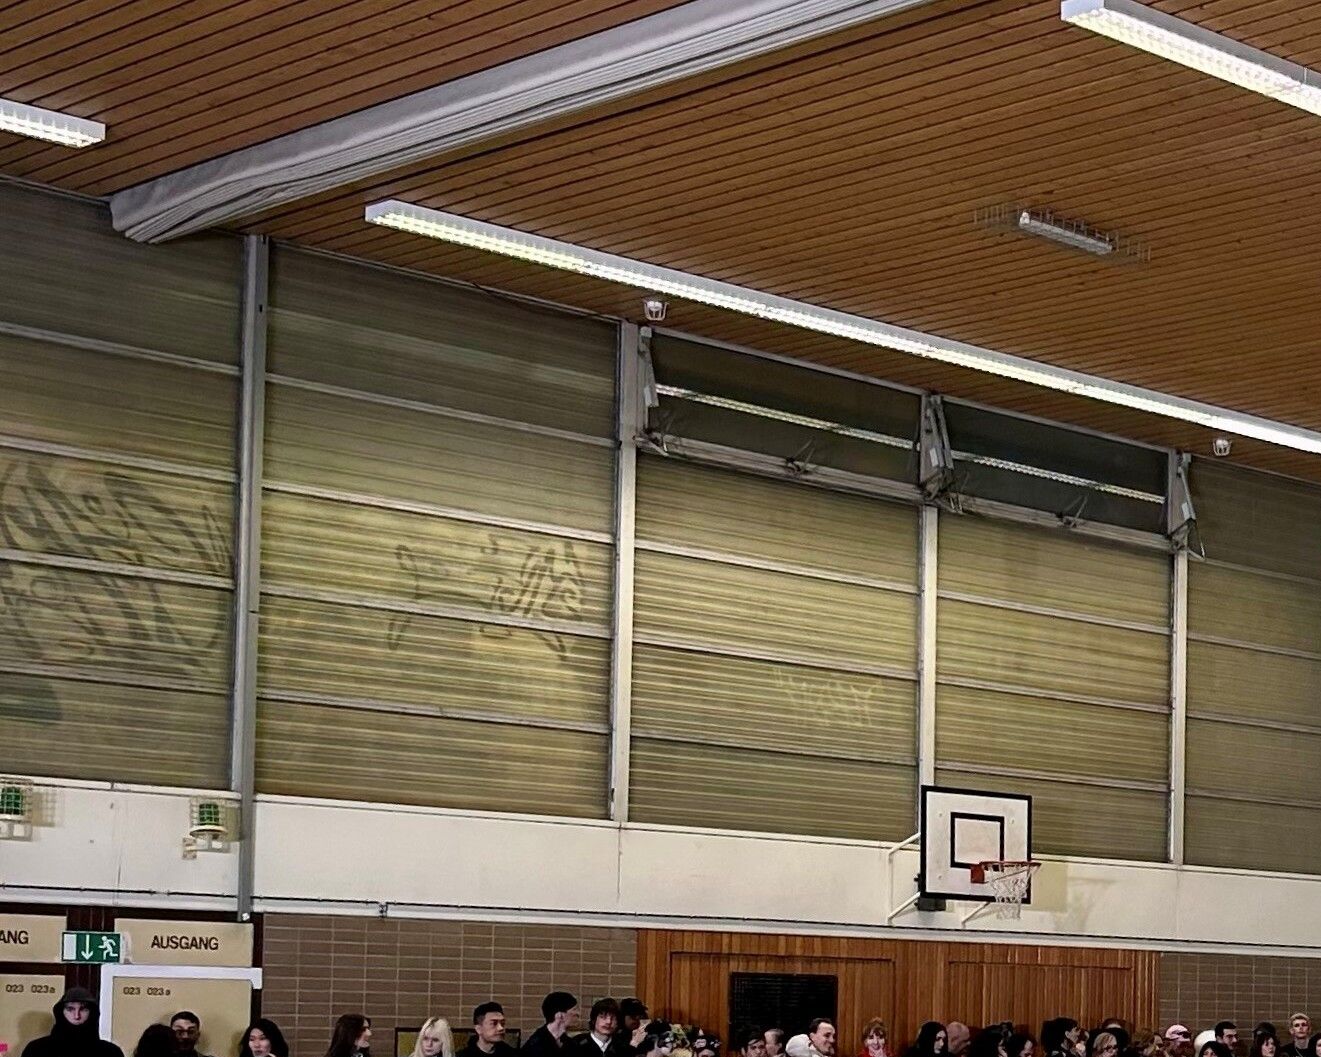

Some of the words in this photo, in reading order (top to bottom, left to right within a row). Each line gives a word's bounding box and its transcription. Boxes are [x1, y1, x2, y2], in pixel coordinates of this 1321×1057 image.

[0, 930, 29, 944] ANG
[151, 935, 219, 950] AUSGANG
[5, 984, 24, 993] 023
[123, 986, 141, 995] 023
